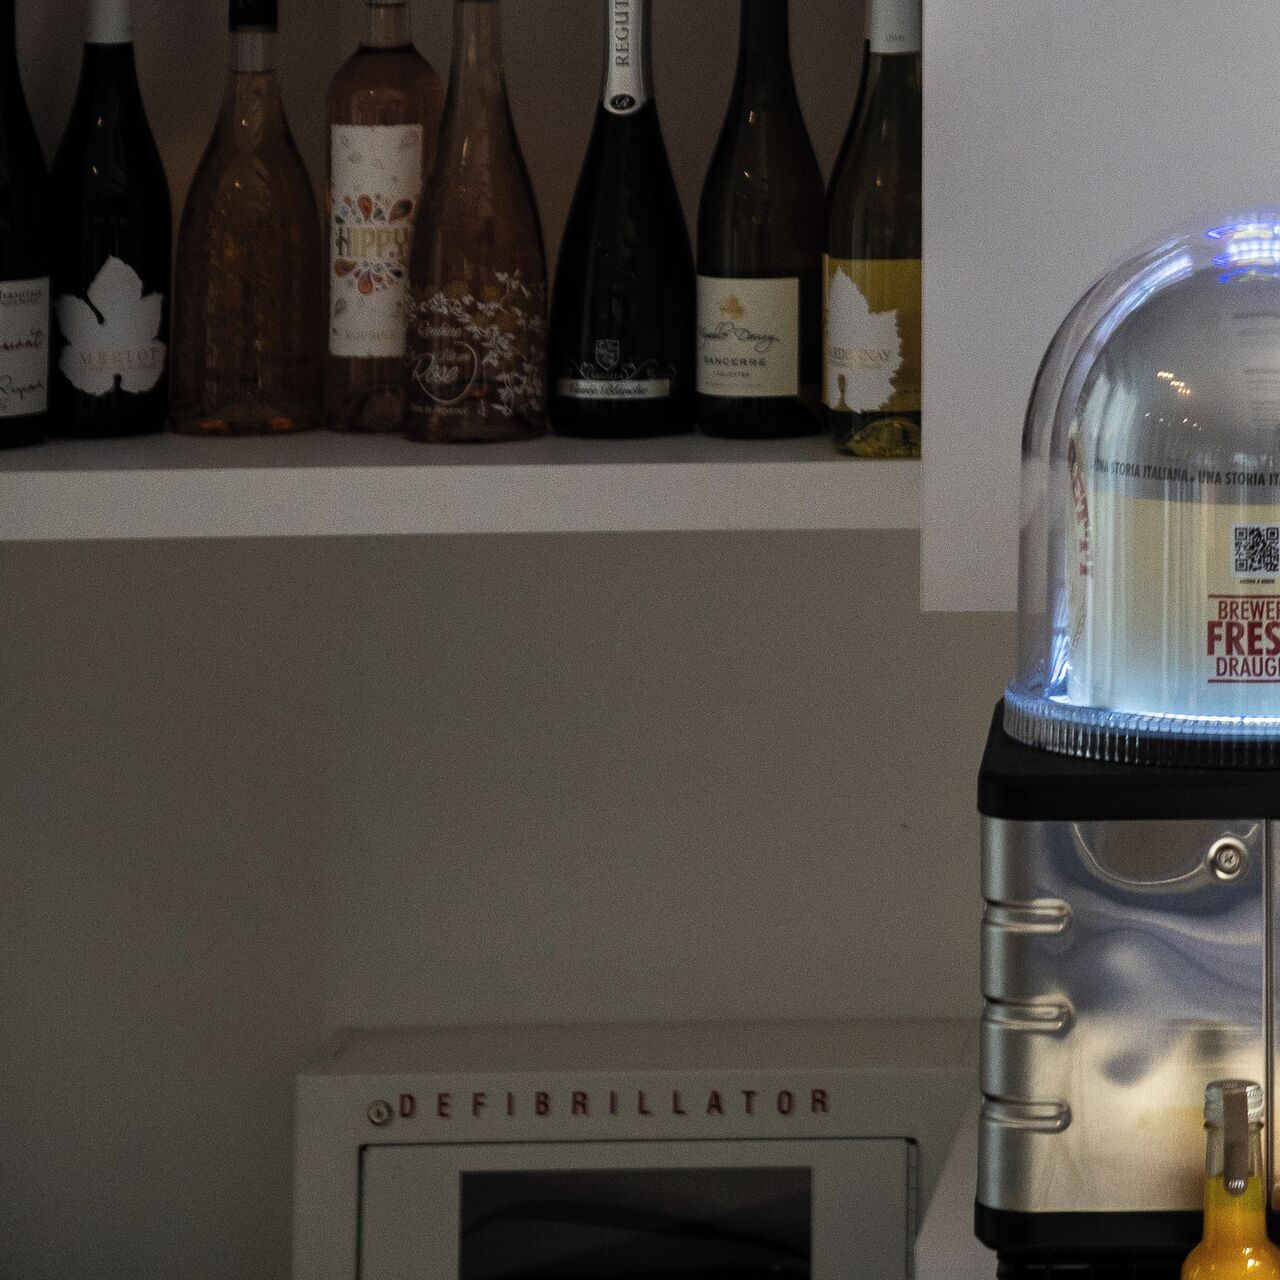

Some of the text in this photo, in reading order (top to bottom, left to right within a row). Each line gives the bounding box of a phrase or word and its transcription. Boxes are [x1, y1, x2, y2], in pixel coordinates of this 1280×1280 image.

[79, 346, 159, 364] MERLOT
[703, 355, 767, 367] SANCERRE
[1143, 463, 1188, 482] ITALIANA
[1198, 470, 1222, 484] UNA
[1225, 471, 1265, 487] STORIA
[397, 1088, 831, 1119] DEFIBRILLATOR
